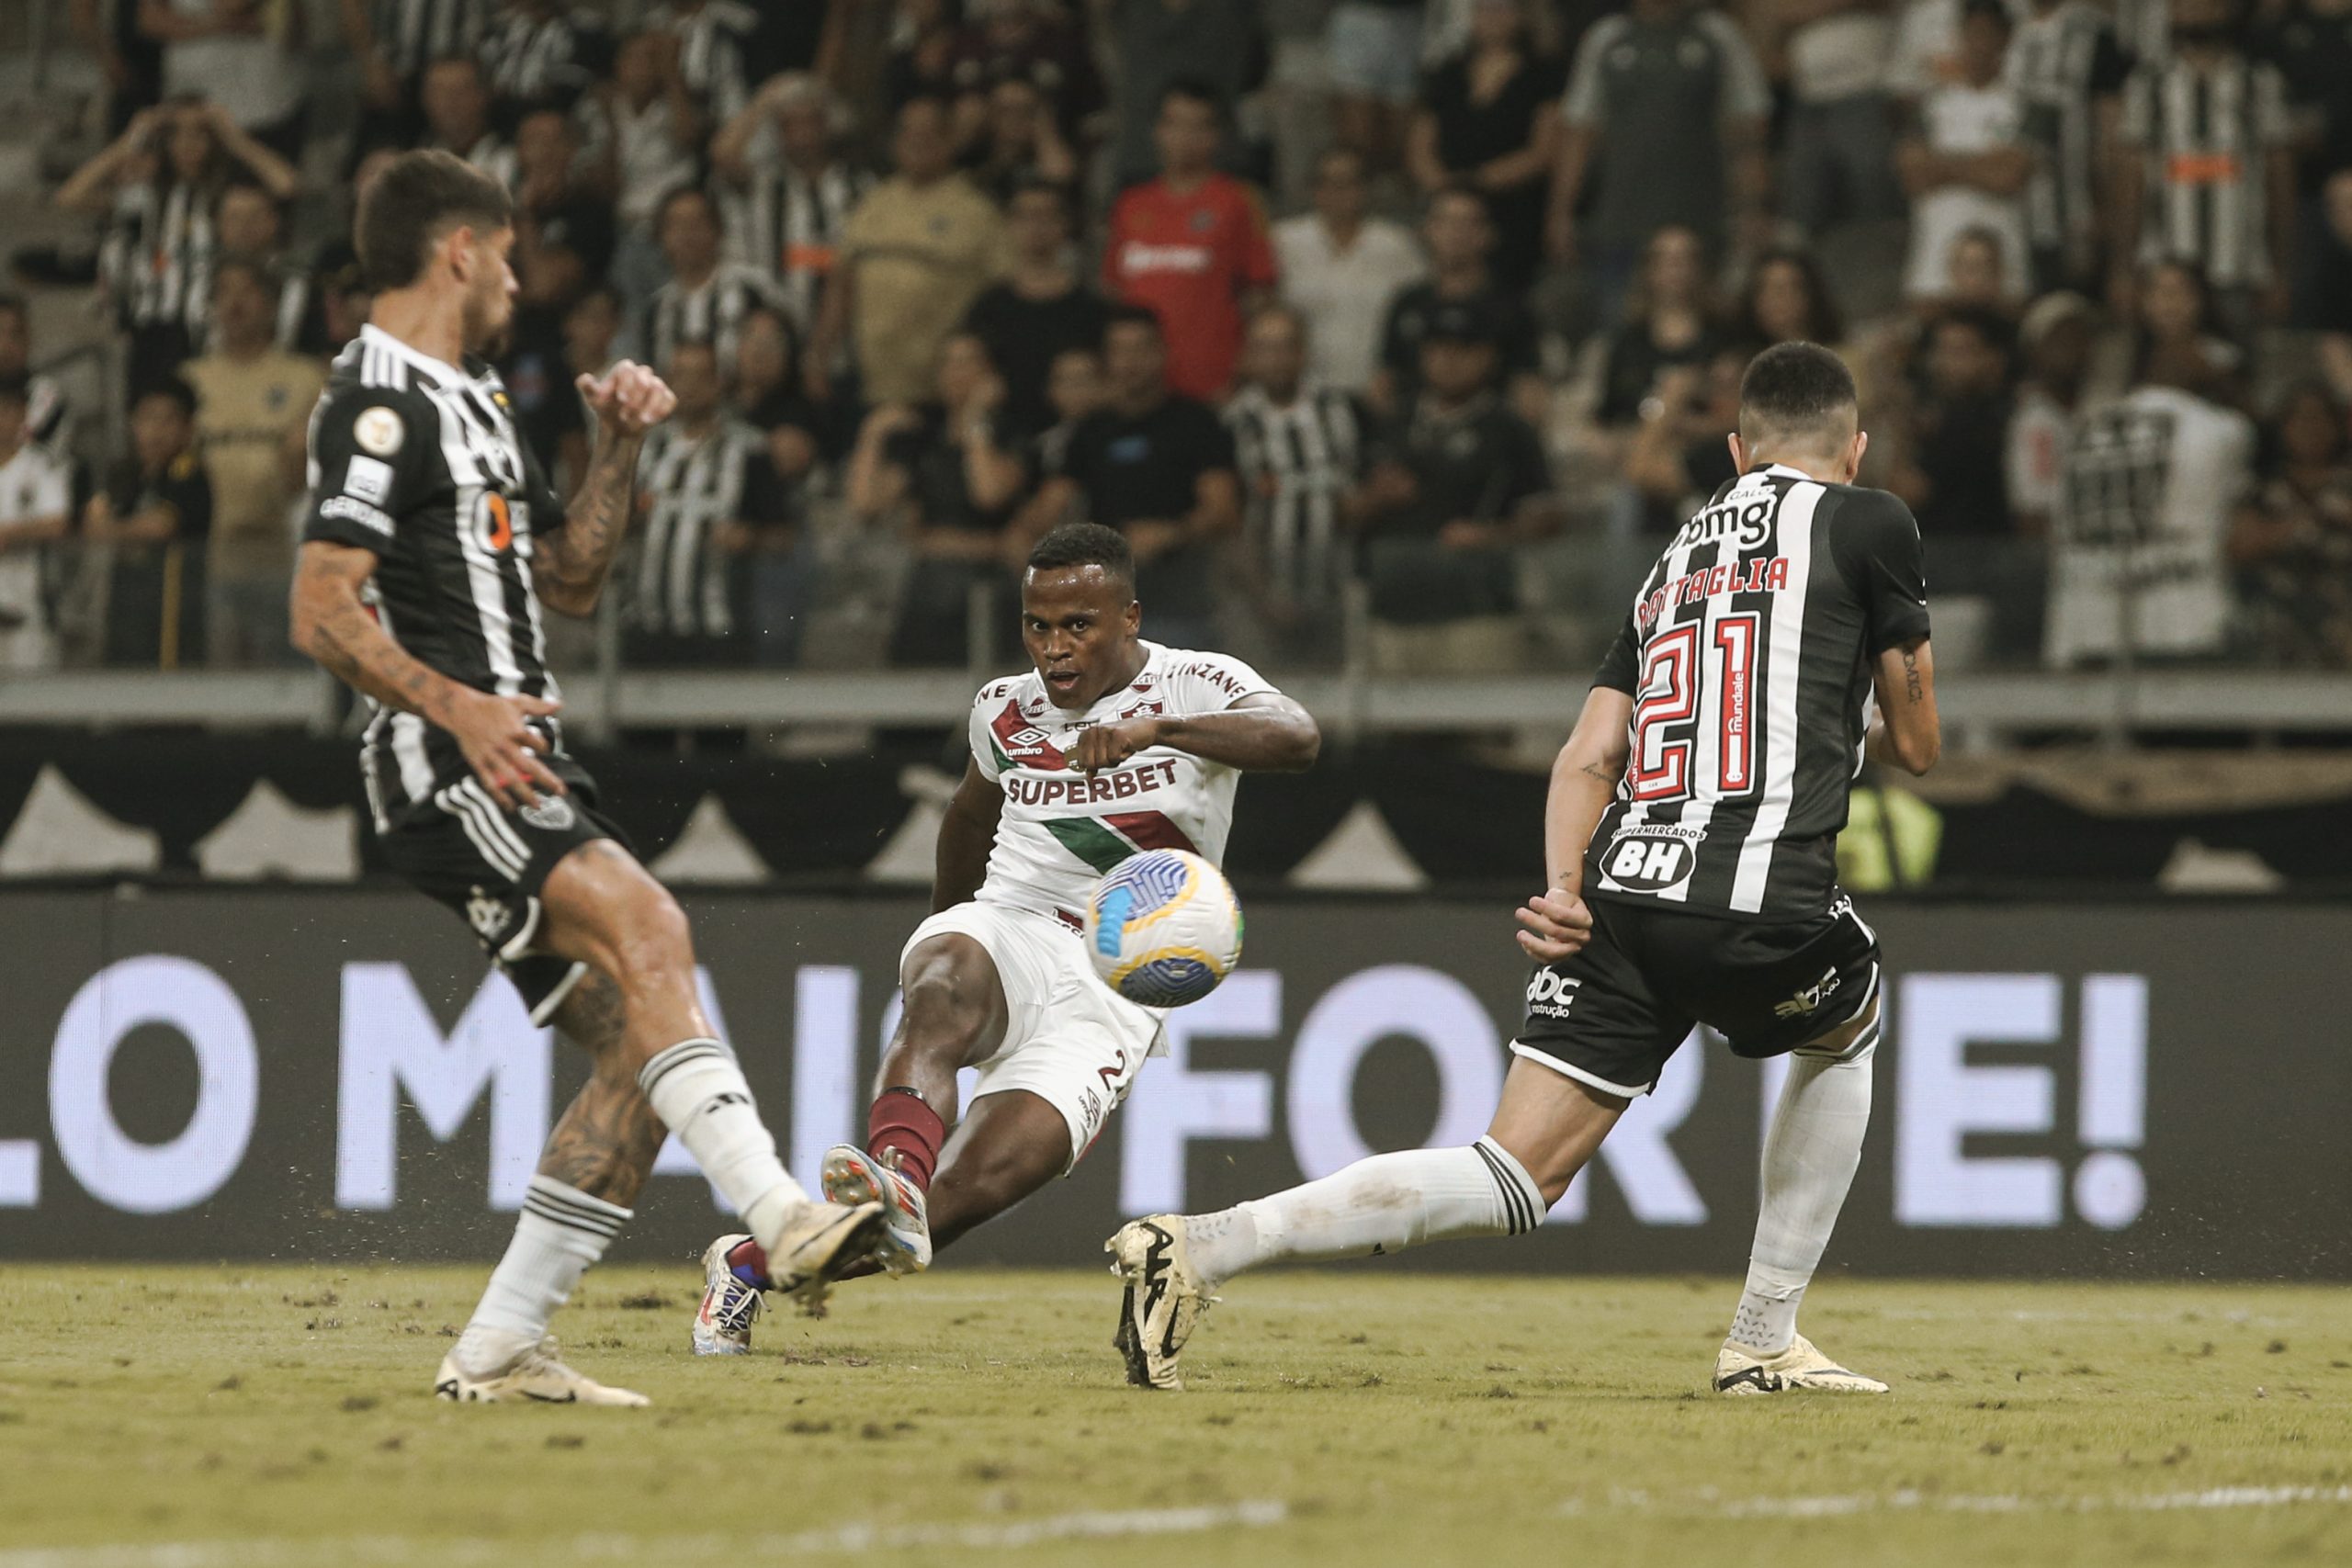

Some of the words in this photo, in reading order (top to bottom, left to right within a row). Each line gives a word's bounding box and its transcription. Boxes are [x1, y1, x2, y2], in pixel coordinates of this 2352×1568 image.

[1633, 612, 1760, 801] 21
[1732, 671, 1744, 733] mundiale
[1008, 746, 1043, 756] umbro
[1009, 759, 1178, 806] SUPERBET
[1612, 826, 1707, 840] SUPERMERCADOS
[1611, 840, 1684, 882] BH
[1527, 965, 1582, 1005] abc
